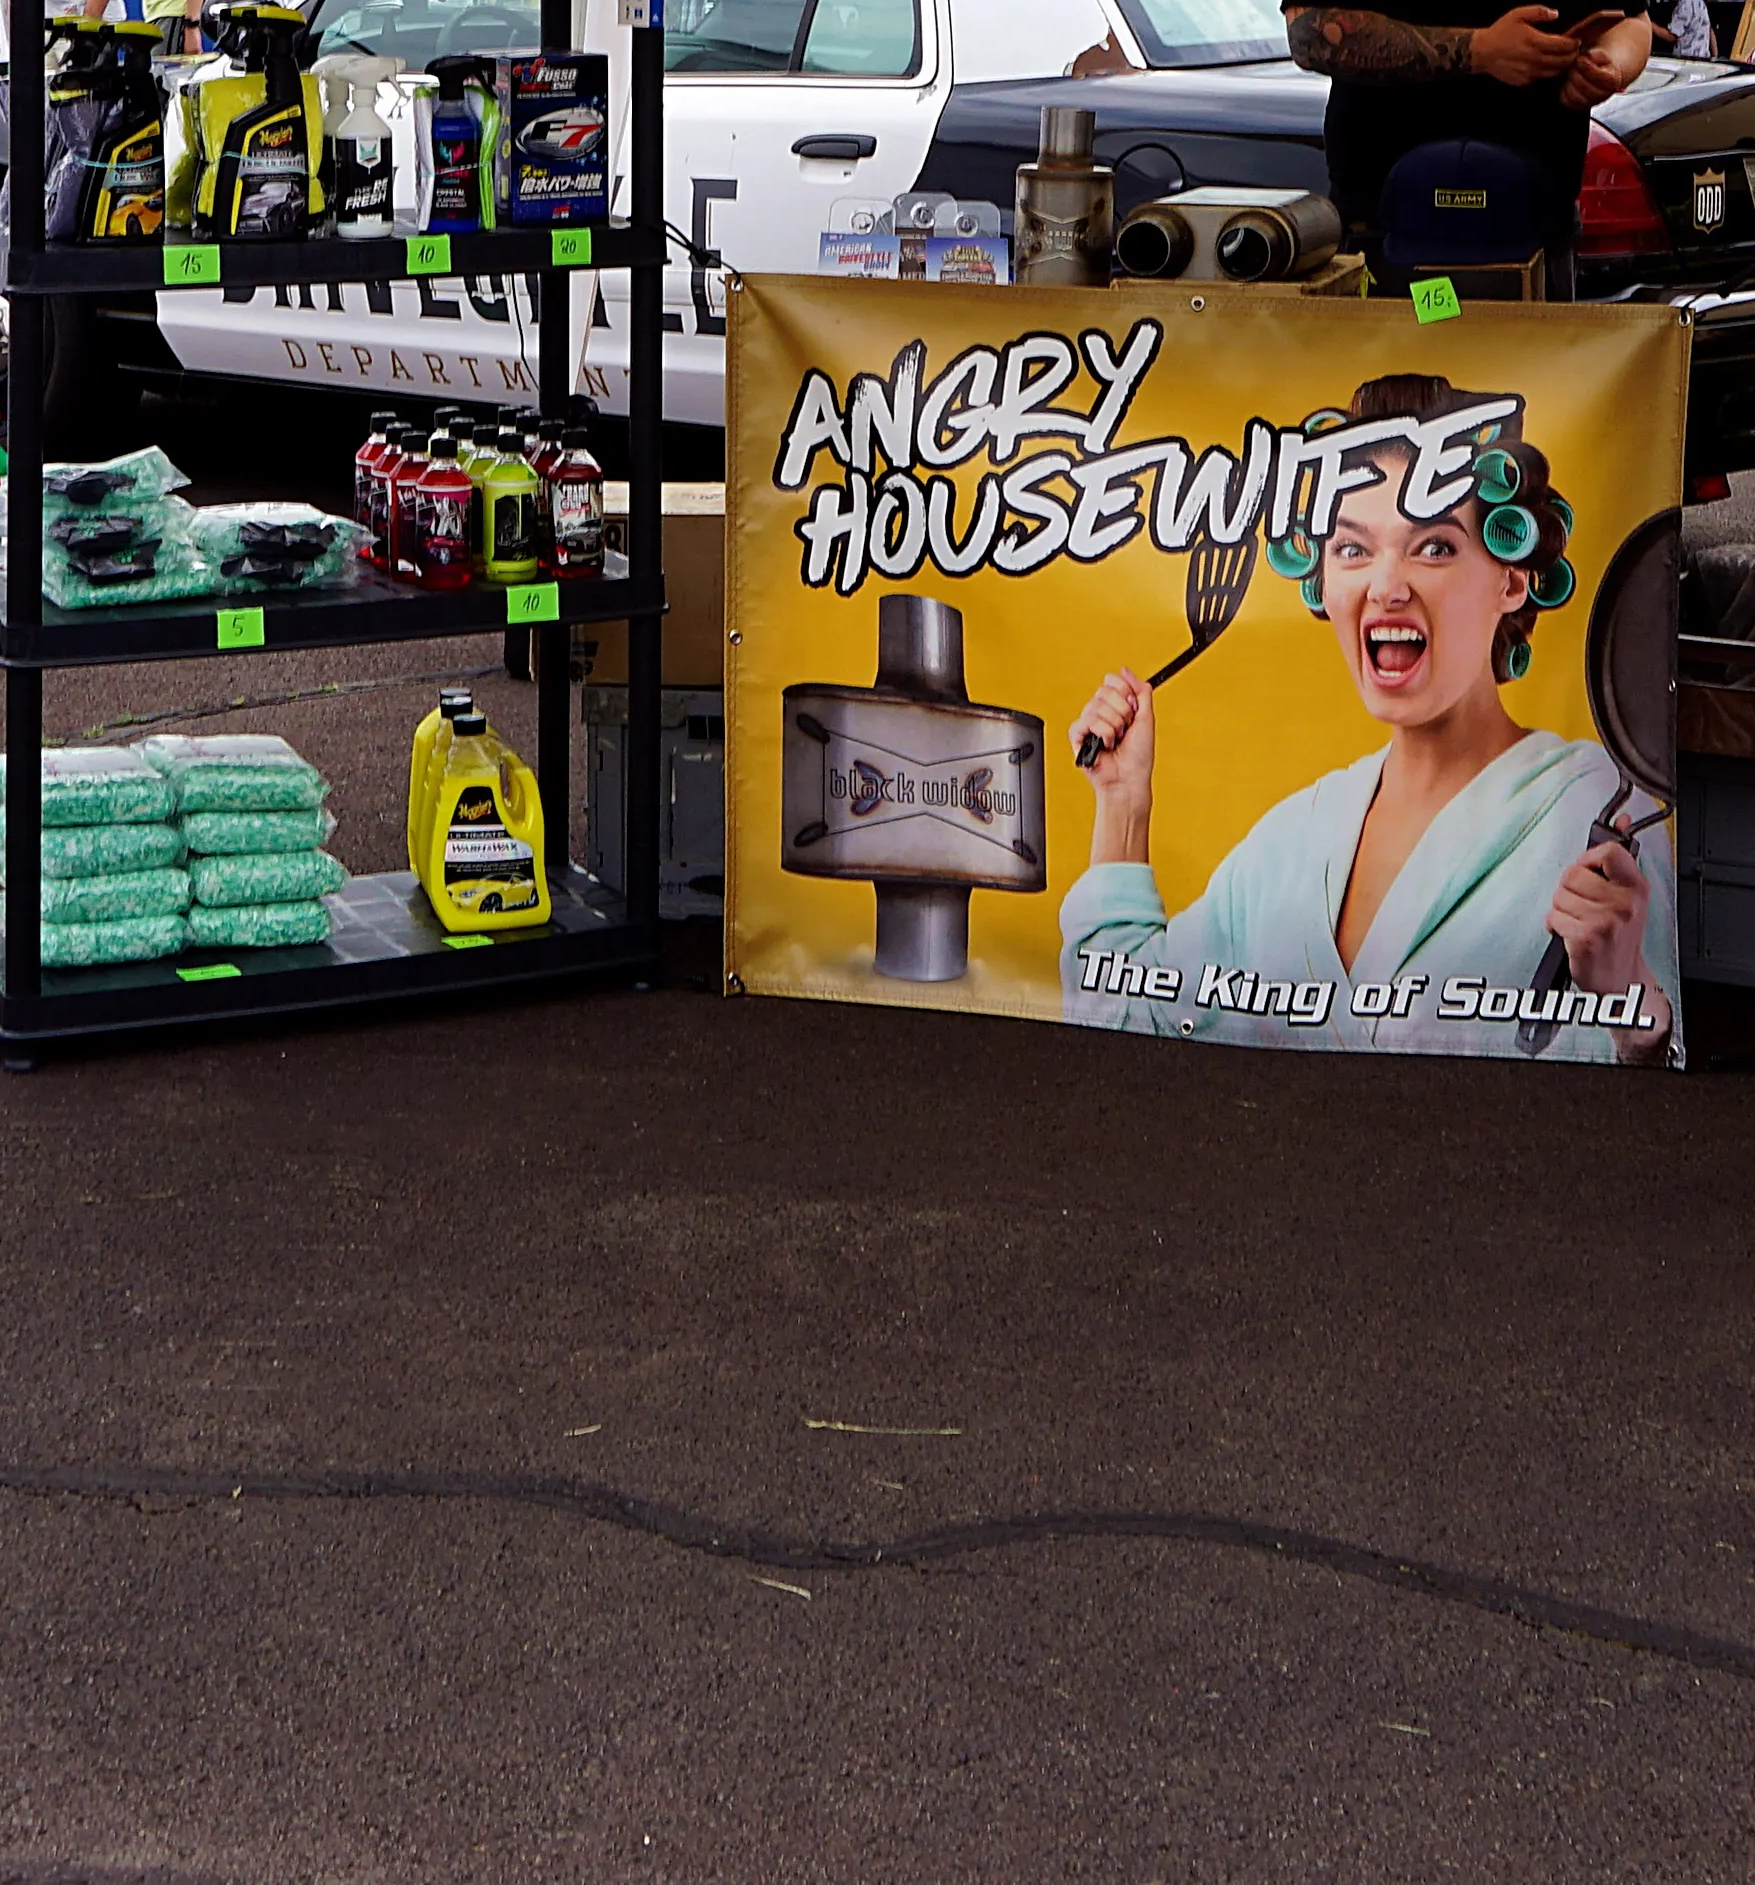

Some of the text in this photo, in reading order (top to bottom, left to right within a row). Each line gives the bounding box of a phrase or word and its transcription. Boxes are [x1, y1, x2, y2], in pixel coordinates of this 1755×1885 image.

[528, 119, 604, 149] F7
[345, 191, 387, 211] FRESH
[1452, 194, 1483, 206] ARMY
[1697, 186, 1722, 224] ODD
[180, 253, 202, 276] 15
[417, 244, 435, 264] 10
[282, 338, 614, 400] DEPARTMN
[776, 319, 1163, 491] ANGRY
[799, 396, 1523, 594] HOUSEWIFE
[522, 592, 541, 614] 10
[231, 615, 246, 638] 5
[829, 767, 1017, 816] black widow
[1078, 947, 1656, 1032] The King of Sound.
